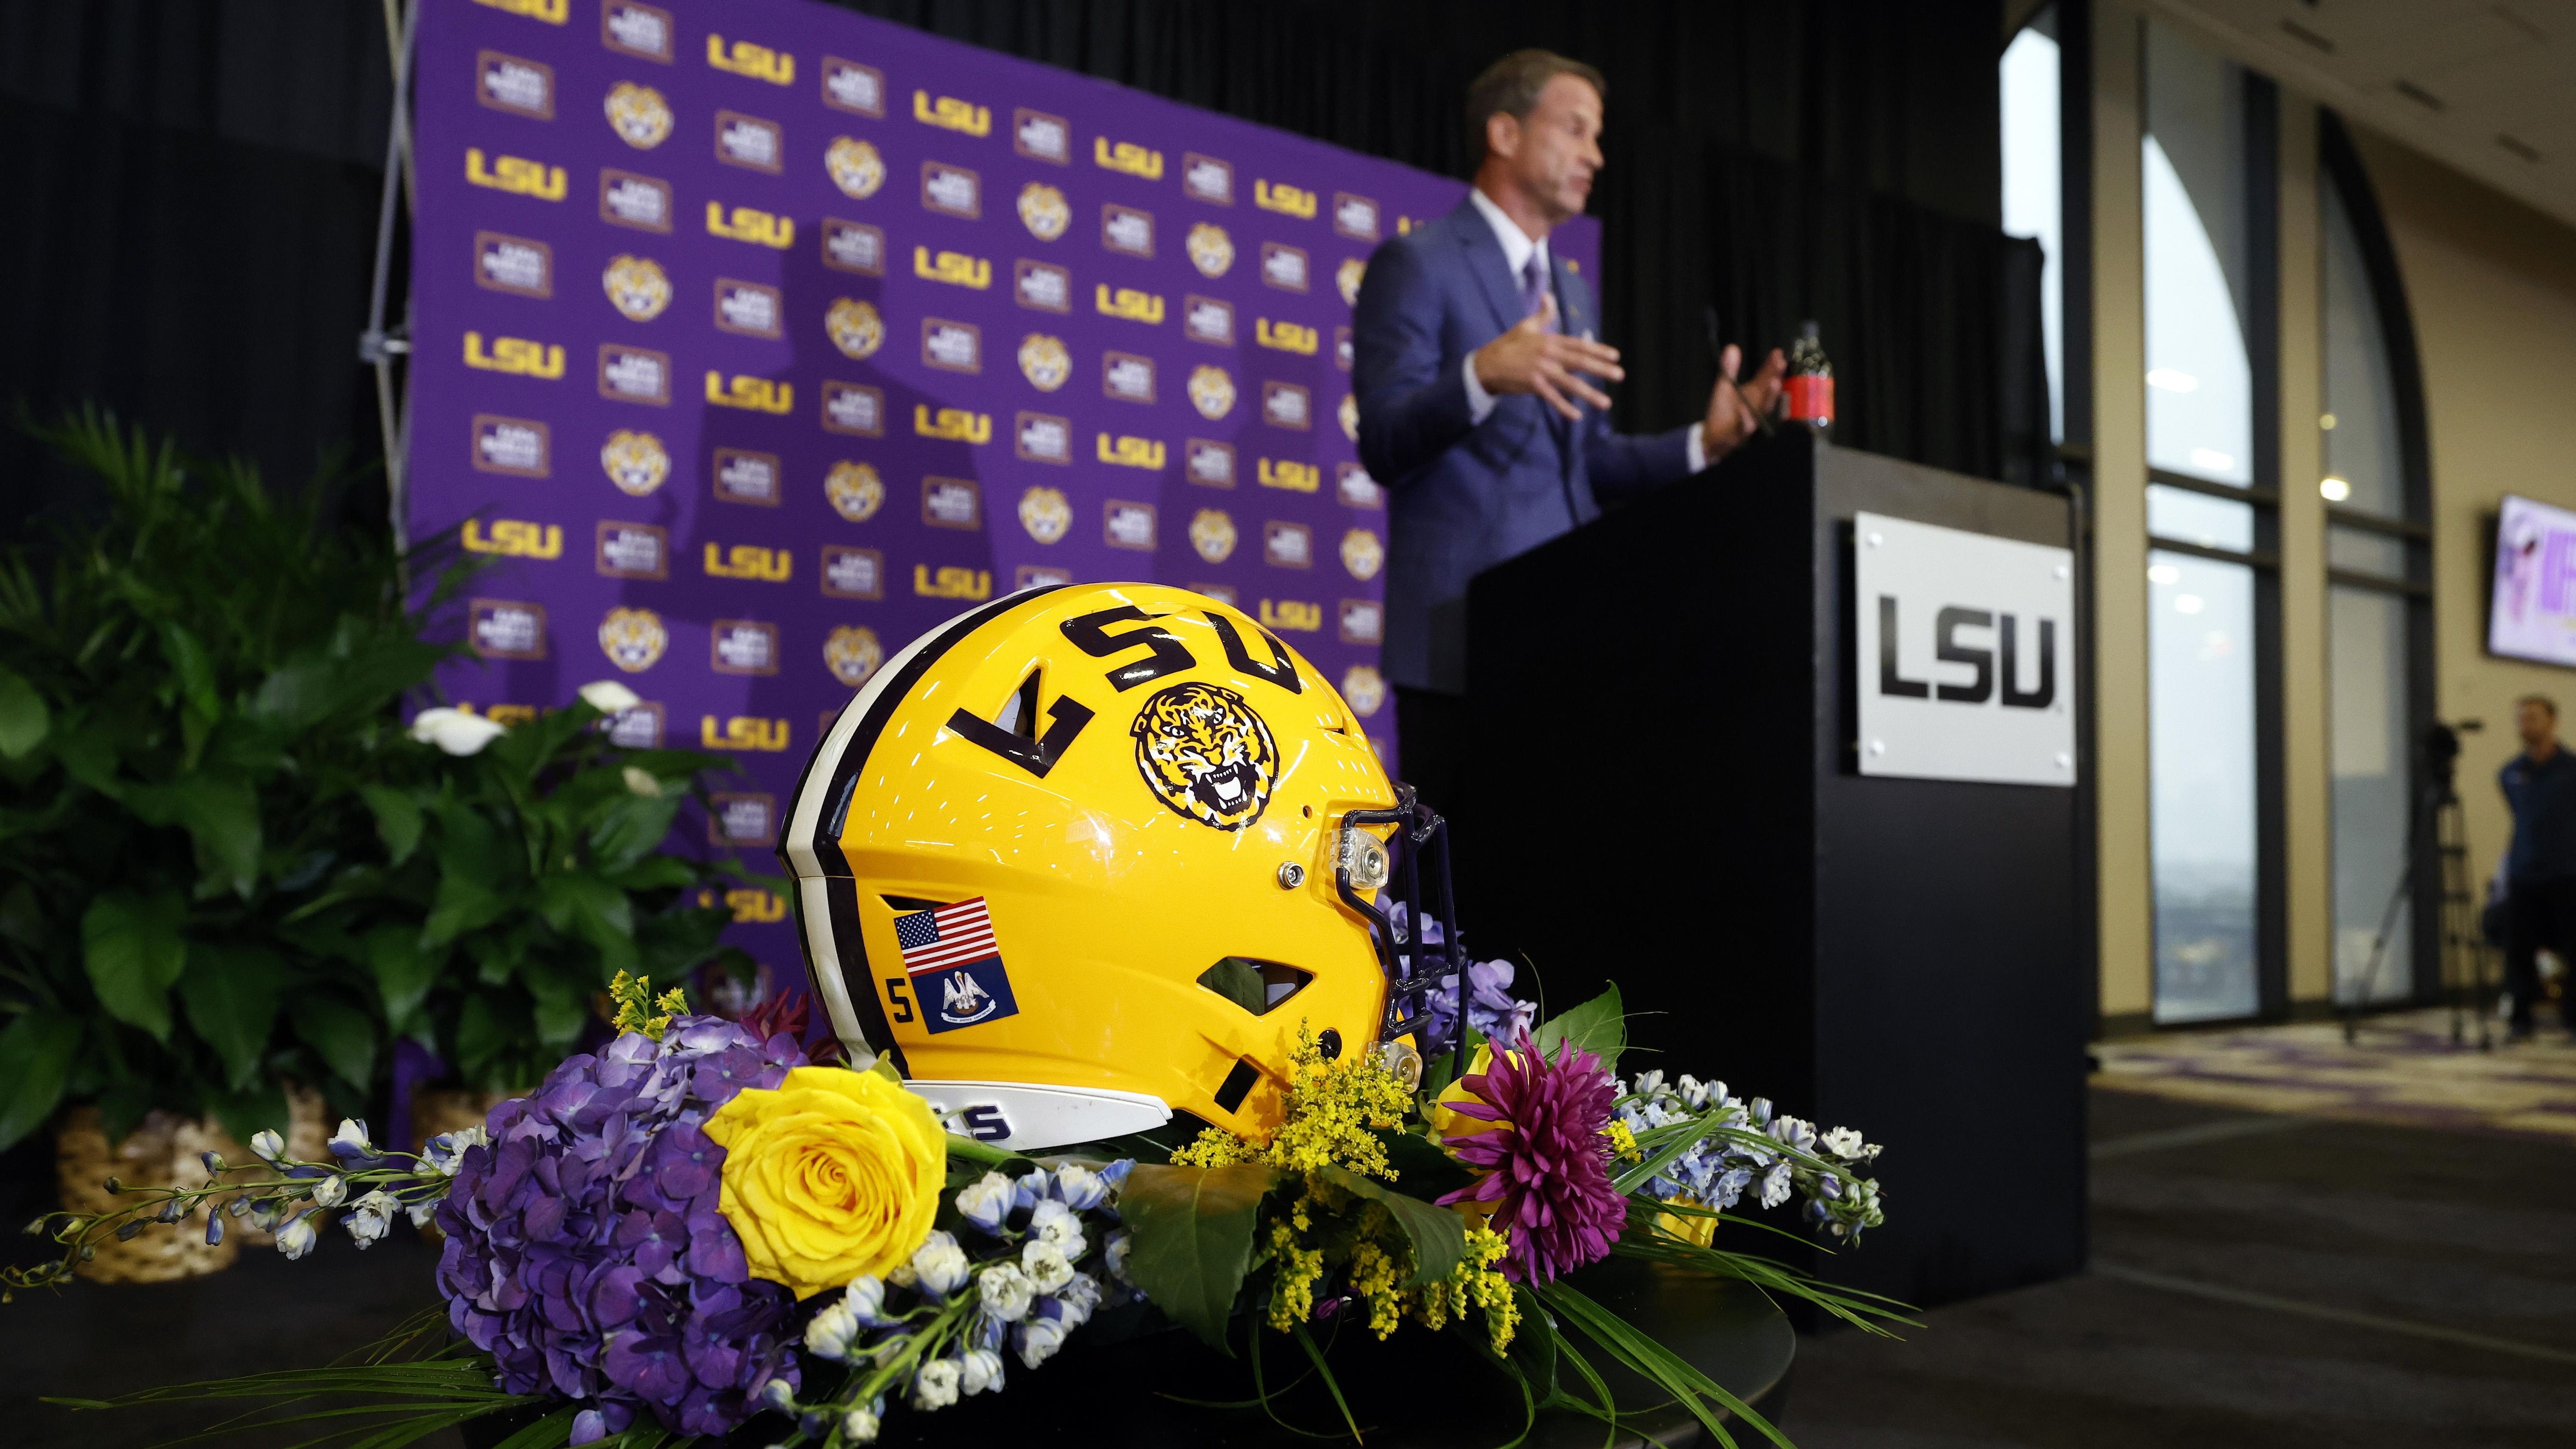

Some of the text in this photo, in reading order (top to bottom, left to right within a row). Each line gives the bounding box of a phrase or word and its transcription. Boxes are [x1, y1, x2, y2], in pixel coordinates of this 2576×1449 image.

[708, 35, 794, 85] LSU
[914, 91, 990, 136] LSU
[466, 149, 567, 201] LSU
[1095, 138, 1163, 179] LSU
[1256, 180, 1316, 218] LSU
[707, 202, 794, 249] LSU
[915, 247, 991, 289] LSU
[1096, 285, 1164, 323] LSU
[464, 332, 565, 379] LSU
[1257, 319, 1317, 355] LSU
[706, 372, 793, 415] LSU
[915, 405, 991, 444] LSU
[1098, 434, 1165, 470] LSU
[1259, 458, 1319, 492] LSU
[462, 519, 563, 559] LSU
[705, 543, 792, 582] LSU
[914, 565, 992, 601] LSU
[1259, 600, 1321, 632] LSU
[1878, 595, 2055, 709] LSU
[945, 605, 1302, 778] LSU
[702, 716, 789, 752] LSU
[886, 978, 913, 1022] 5
